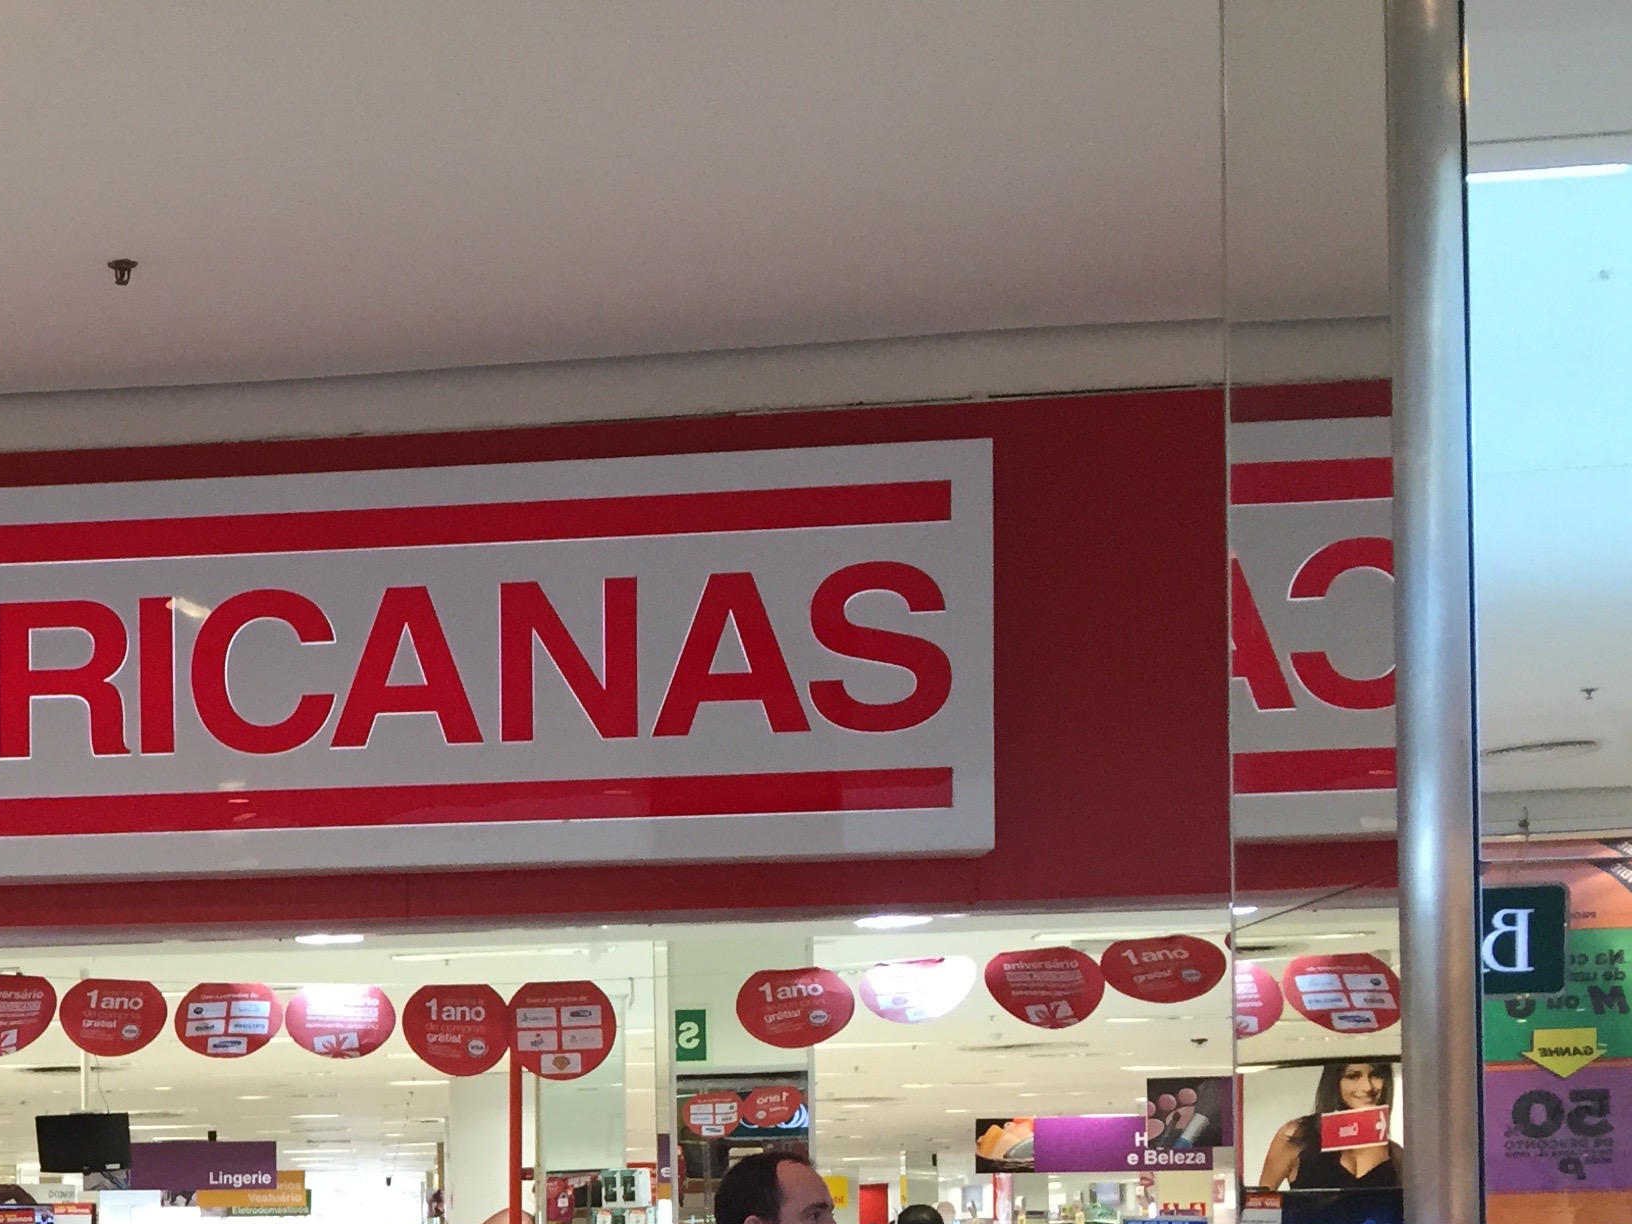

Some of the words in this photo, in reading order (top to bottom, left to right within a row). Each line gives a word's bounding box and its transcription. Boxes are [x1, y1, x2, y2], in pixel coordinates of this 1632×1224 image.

[1120, 948, 1138, 966] 1
[1142, 948, 1190, 963] ano
[86, 989, 100, 1009] 1
[101, 990, 145, 1012] ano
[759, 982, 773, 1003] 1
[776, 982, 824, 999] ano
[425, 997, 438, 1021] 1
[441, 1005, 486, 1022] ano
[1126, 1152, 1139, 1165] e
[1144, 1149, 1206, 1165] Beleza
[208, 1171, 272, 1188] Lingerie
[248, 1191, 303, 1204] Vestuário
